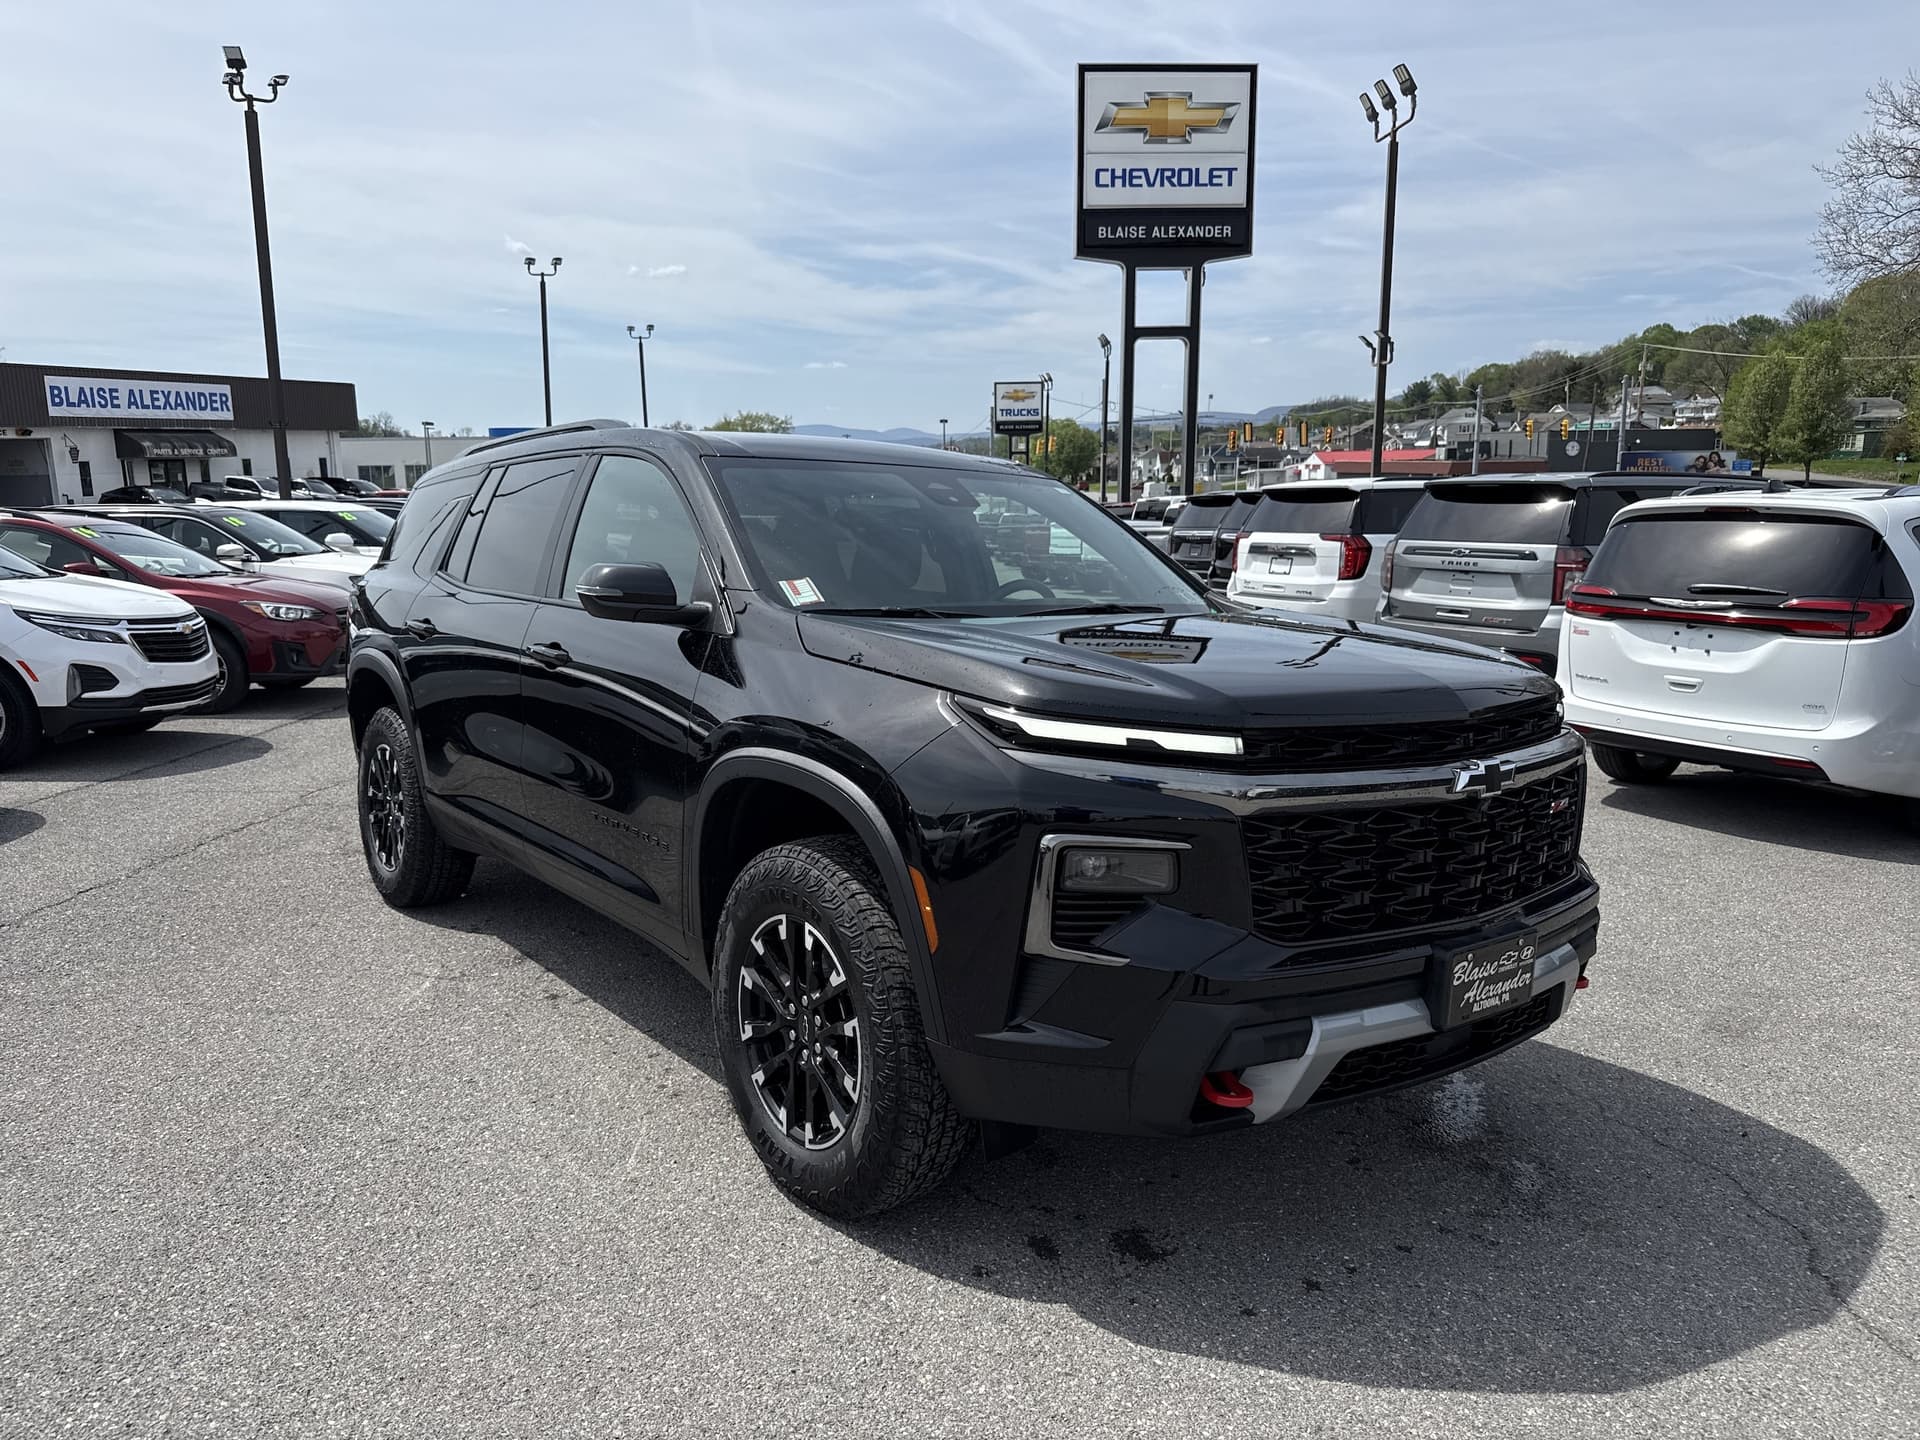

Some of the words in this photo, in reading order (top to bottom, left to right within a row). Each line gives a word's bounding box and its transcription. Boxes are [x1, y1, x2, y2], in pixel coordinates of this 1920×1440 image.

[1094, 167, 1238, 188] CHEVROLET
[1097, 226, 1147, 239] BLAISE
[1151, 225, 1232, 238] ALEXANDER
[49, 385, 121, 409] BLAISE
[127, 388, 231, 412] ALEXANDER
[999, 408, 1040, 417] TRUCKS
[152, 448, 173, 456] PARTS
[180, 448, 204, 456] SERVICE
[206, 448, 229, 456] CENTER
[1637, 457, 1664, 466] REST
[1440, 560, 1479, 568] TAHOE
[1453, 961, 1499, 986] Blaise
[1460, 968, 1532, 1008] Alexander
